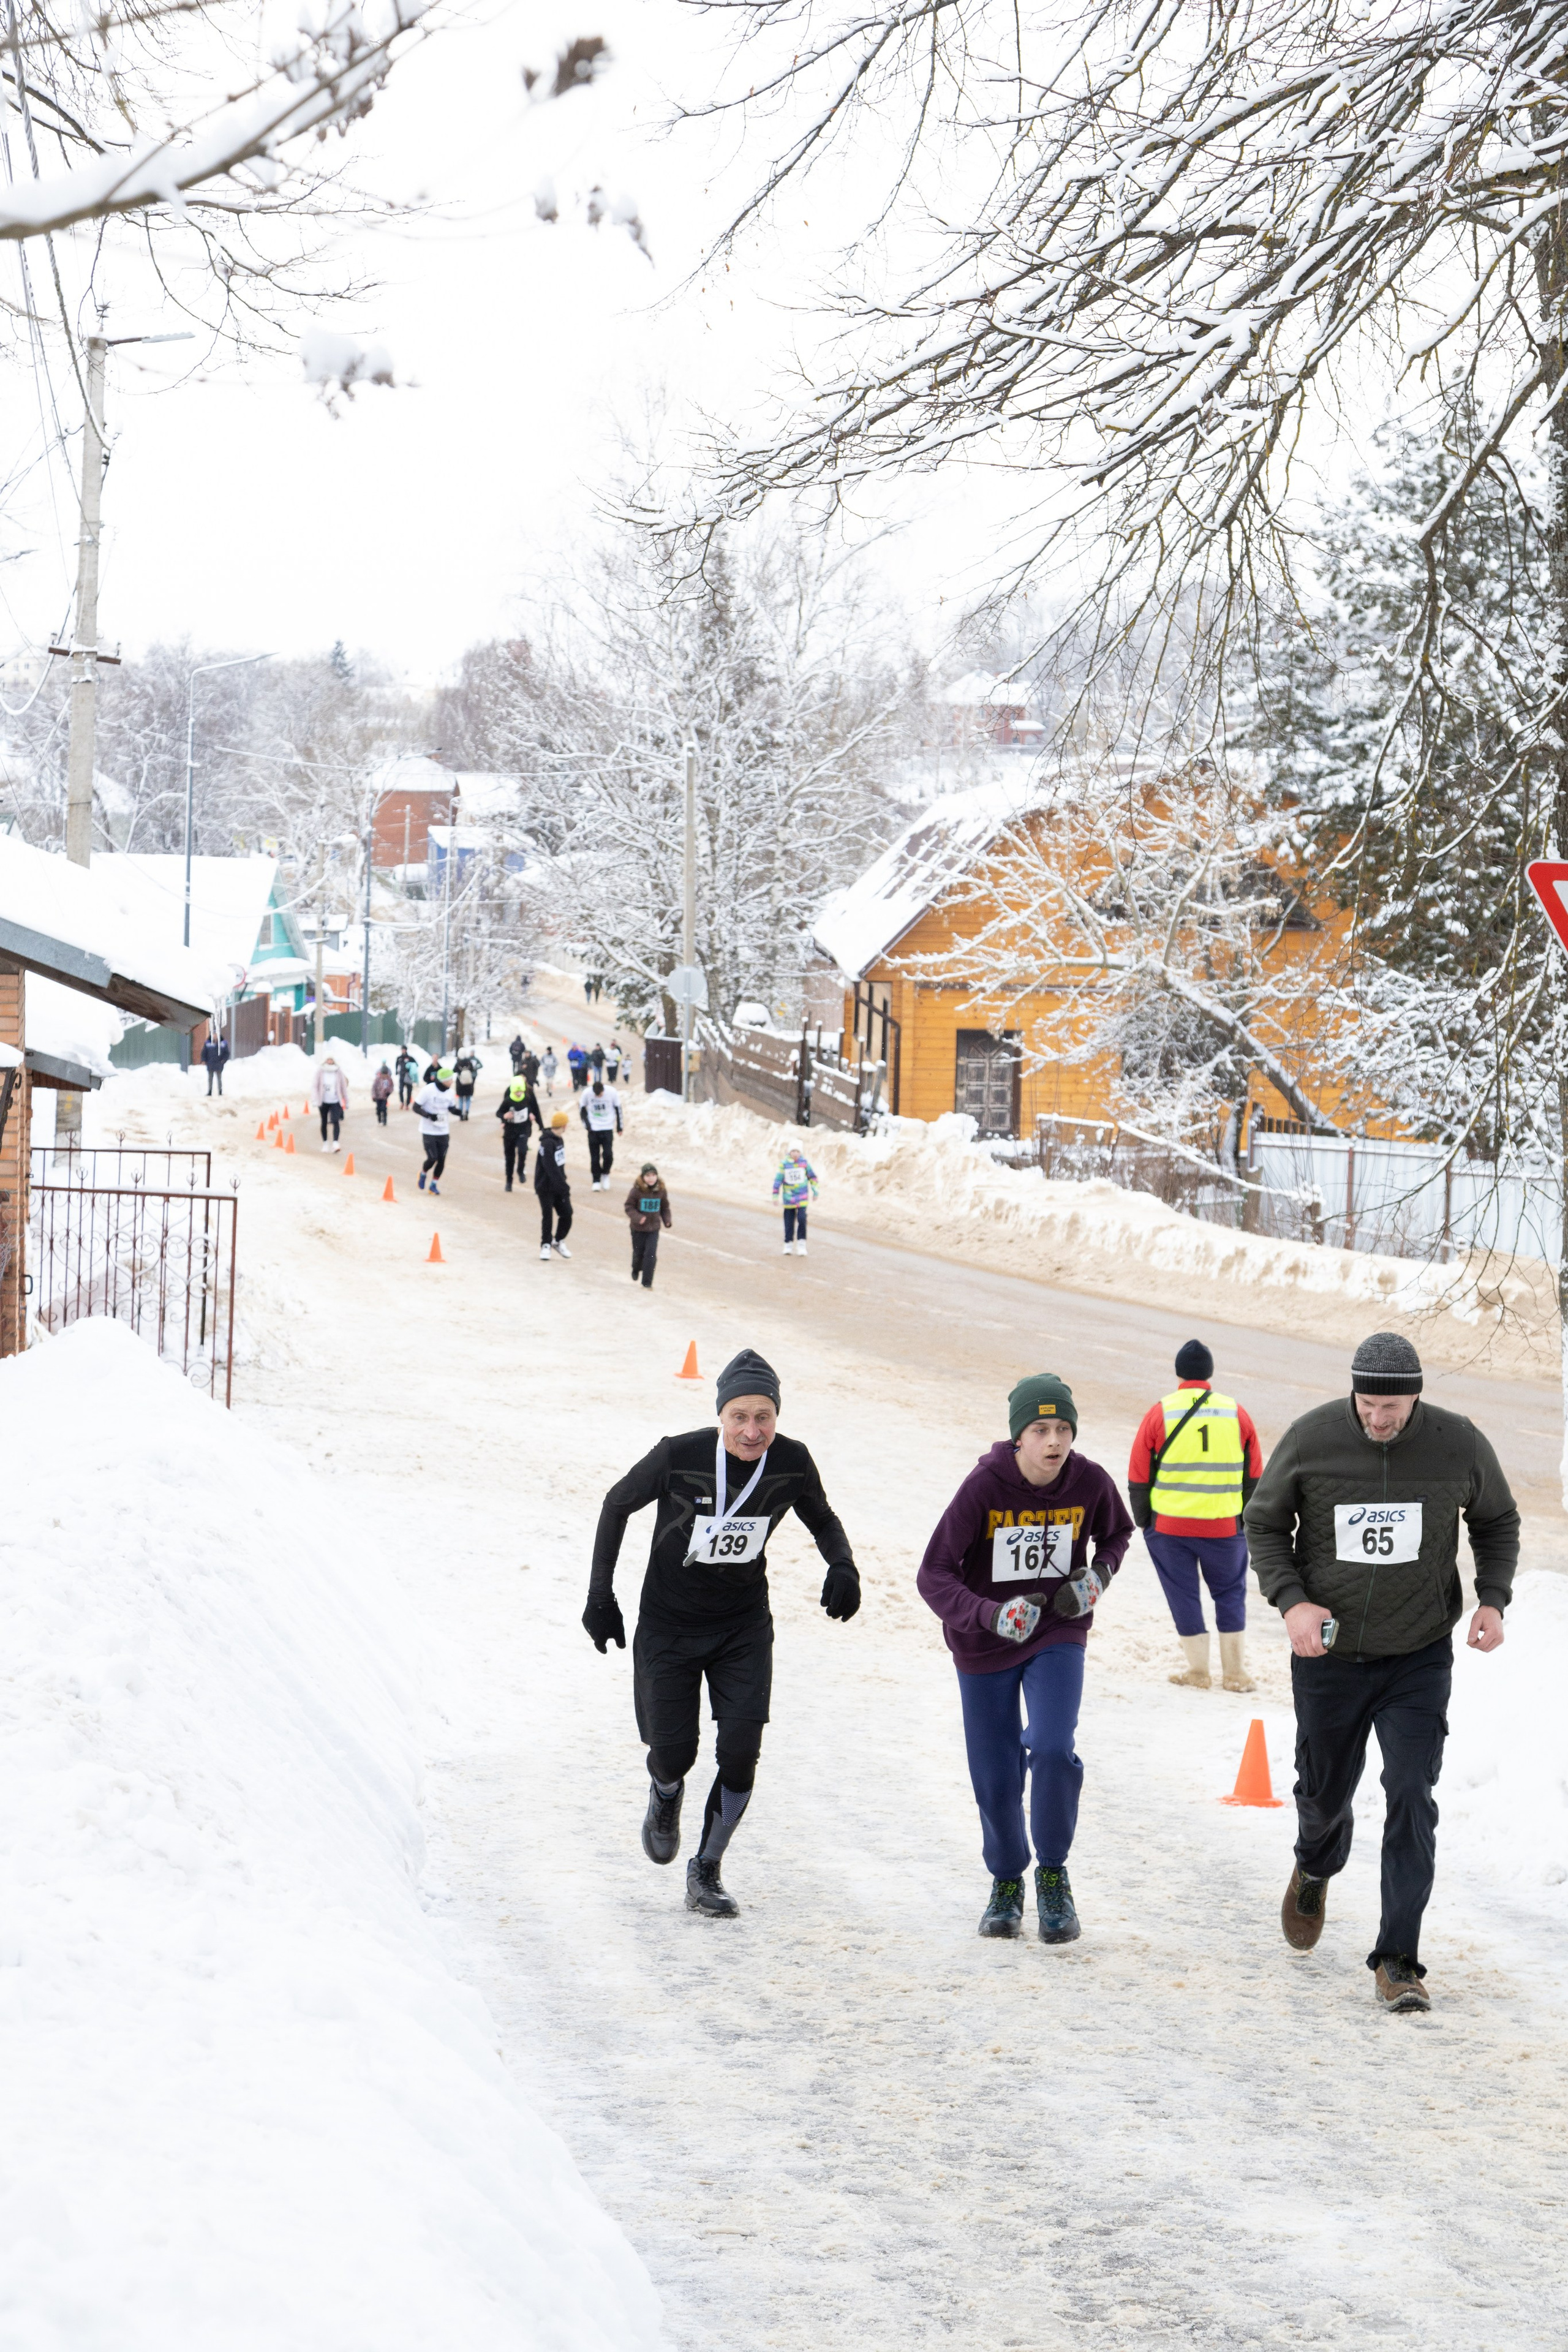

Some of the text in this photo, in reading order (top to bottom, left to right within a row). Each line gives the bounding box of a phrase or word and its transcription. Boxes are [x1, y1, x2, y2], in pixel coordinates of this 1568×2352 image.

[1197, 1424, 1208, 1452] 1
[709, 1534, 748, 1558] 139
[1362, 1527, 1394, 1556] 65
[1011, 1544, 1057, 1571] 167
